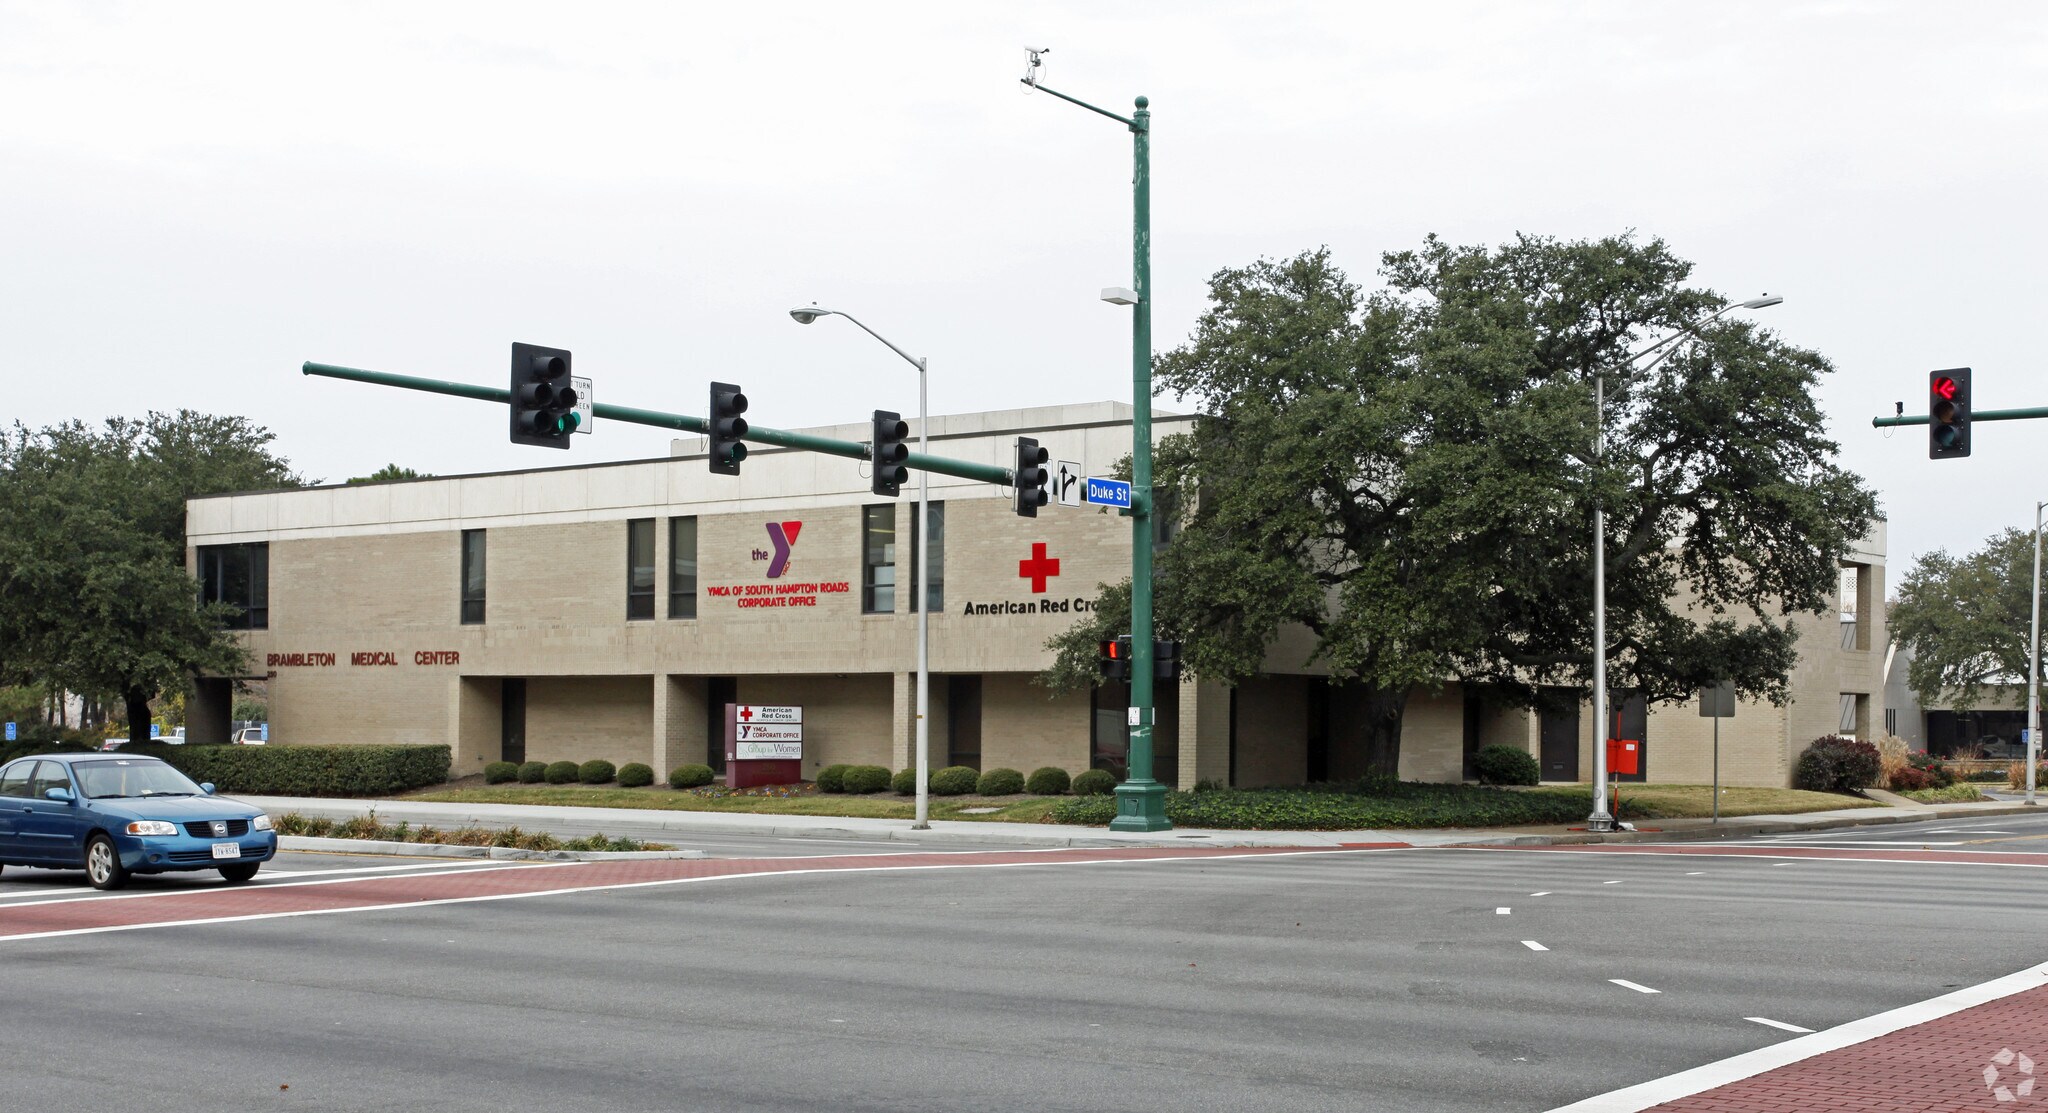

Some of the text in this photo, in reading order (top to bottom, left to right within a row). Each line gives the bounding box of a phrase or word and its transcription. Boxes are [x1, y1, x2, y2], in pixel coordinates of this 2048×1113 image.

[576, 381, 590, 389] TURN
[1091, 484, 1127, 502] Duke St
[752, 548, 768, 560] the
[781, 561, 791, 576] YMCA
[707, 582, 849, 596] YMCA OF SOUTH HAMPTON ROADS
[737, 596, 816, 608] CORPORATE OFFICE
[963, 597, 1099, 615] American Red Cro
[266, 650, 460, 667] BRAMBLETON MEDICAL CENTER
[748, 744, 767, 754] Group
[774, 743, 800, 753] Women
